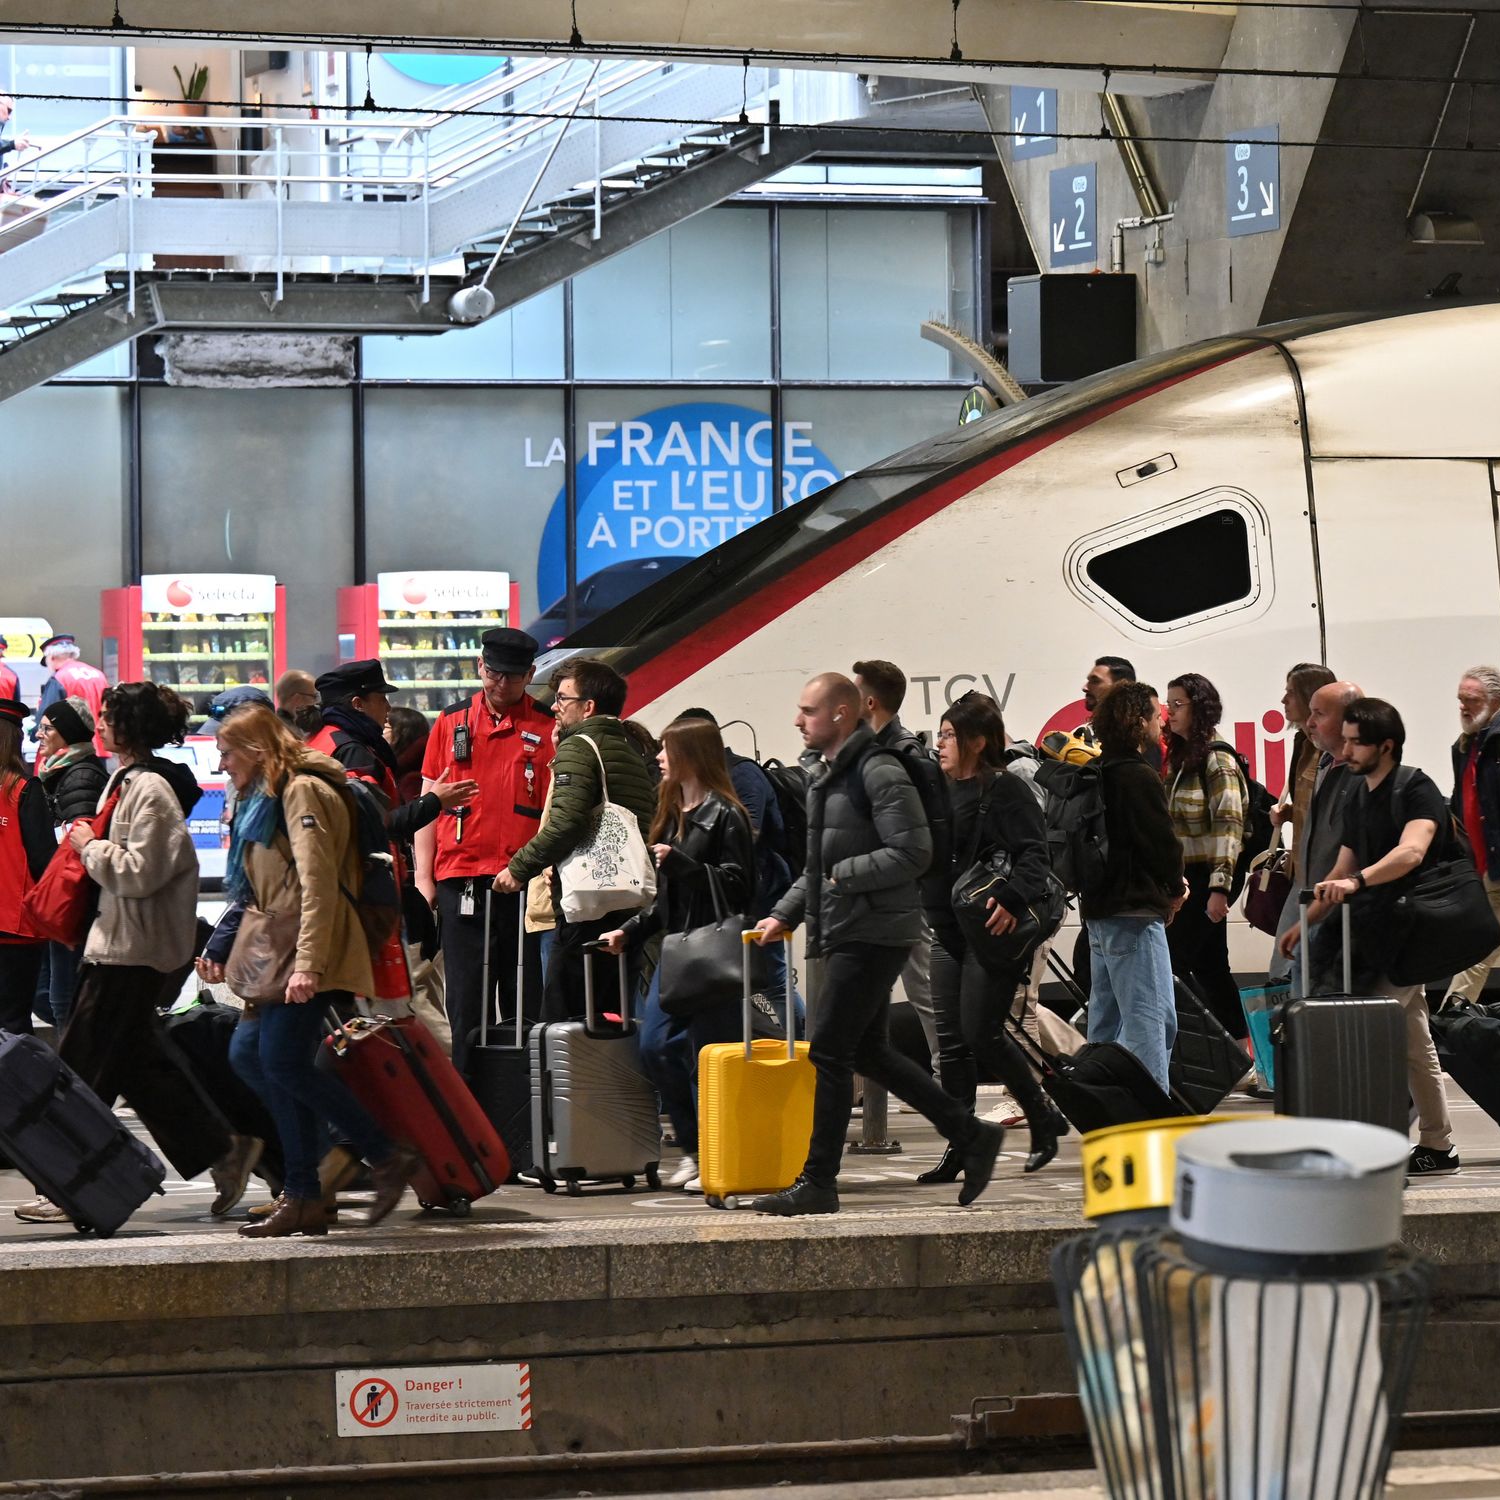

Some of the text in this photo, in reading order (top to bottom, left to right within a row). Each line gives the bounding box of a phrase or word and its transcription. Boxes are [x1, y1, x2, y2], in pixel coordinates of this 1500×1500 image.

[1036, 91, 1045, 132] 1
[1238, 166, 1249, 211] 3
[1075, 197, 1085, 240] 2
[524, 421, 814, 467] LA FRANCE
[613, 470, 860, 511] ET L'EURO
[587, 512, 616, 548] À
[405, 1378, 463, 1393] Danger !
[406, 1398, 512, 1410] Traversée strictement
[406, 1412, 449, 1423] interdite
[466, 1411, 500, 1422] public.
